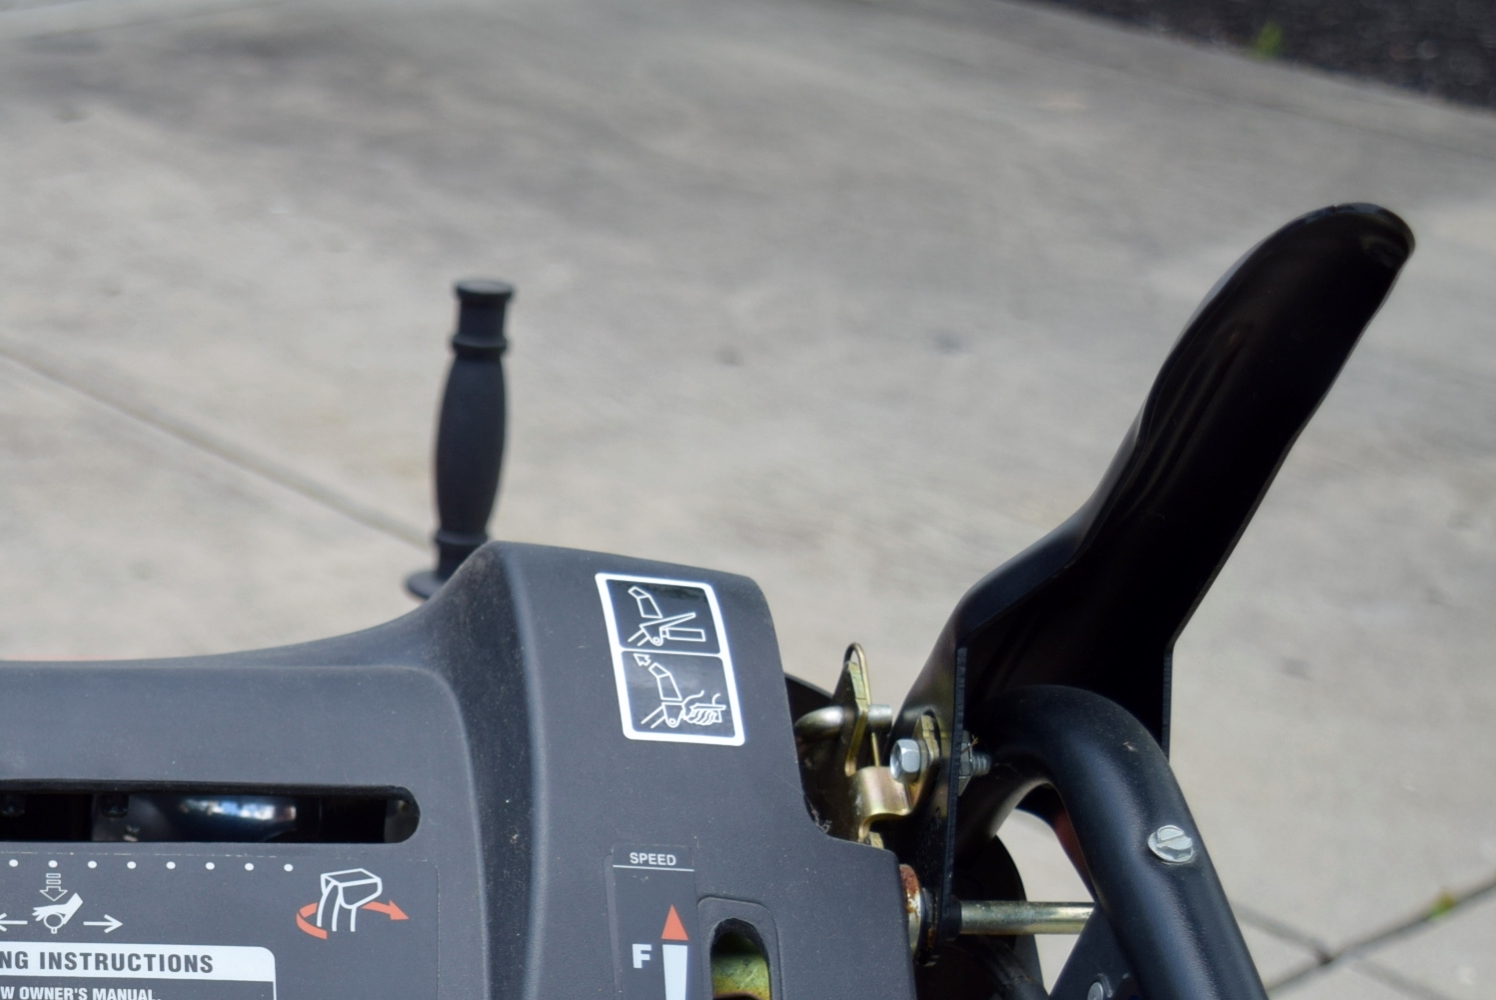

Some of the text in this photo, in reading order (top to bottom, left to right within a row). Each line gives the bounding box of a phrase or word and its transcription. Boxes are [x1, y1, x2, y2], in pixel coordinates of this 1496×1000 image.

[630, 852, 676, 865] SPEED
[40, 952, 212, 973] INSTRUCTIONS
[633, 944, 651, 968] F
[20, 987, 87, 1000] OWNER'S
